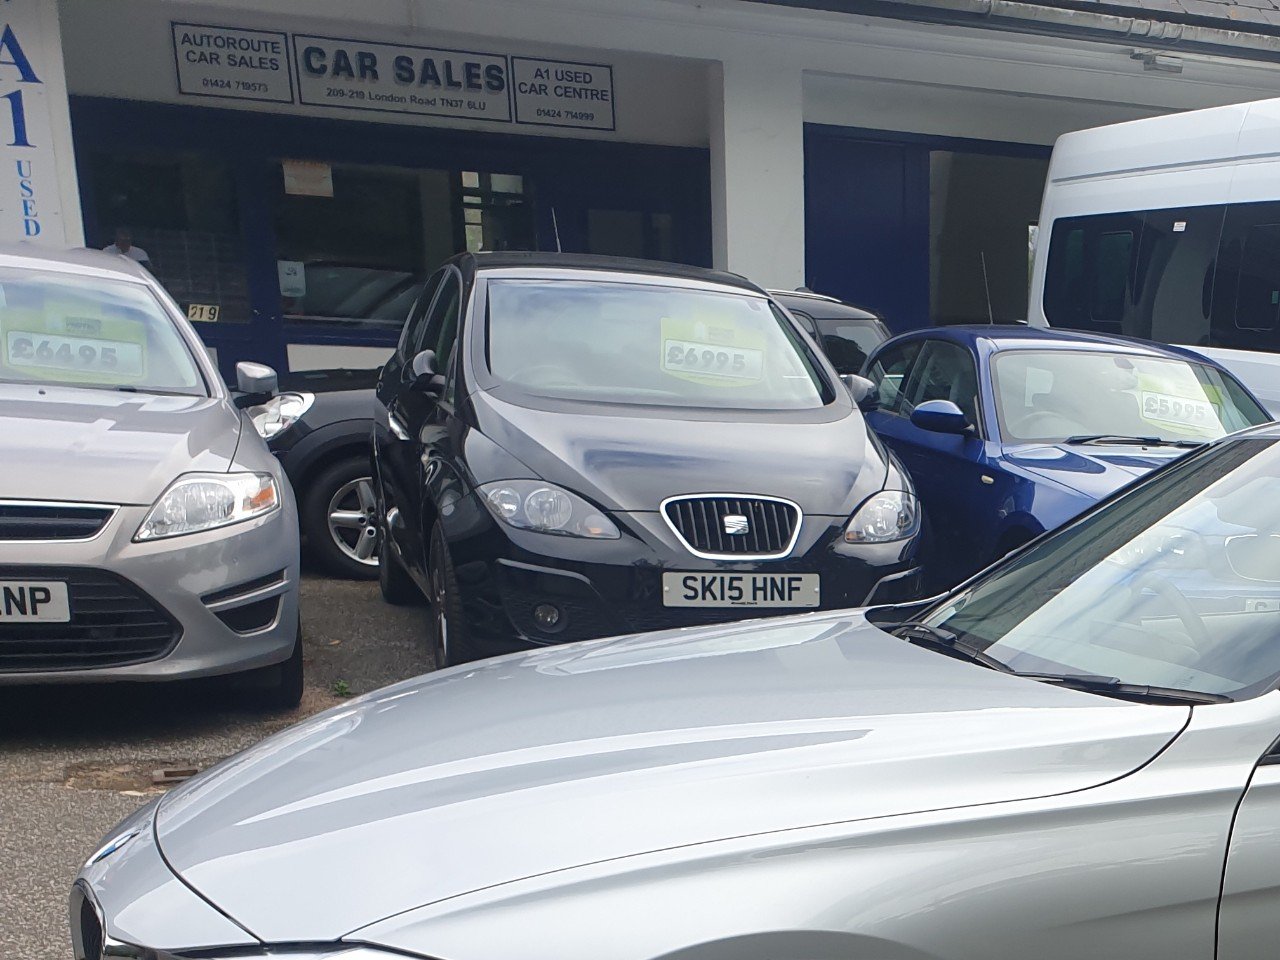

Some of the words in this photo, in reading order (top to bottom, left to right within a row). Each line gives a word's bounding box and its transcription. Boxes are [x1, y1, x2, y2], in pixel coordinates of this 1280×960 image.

[181, 33, 281, 54] AUTOROUTE
[186, 50, 220, 65] CAR
[227, 54, 280, 71] SALES
[303, 46, 379, 81] CAR
[394, 55, 506, 92] SALES
[202, 77, 232, 89] 01424
[534, 67, 551, 80] A1
[555, 70, 593, 84] USED
[368, 91, 407, 103] London
[410, 94, 437, 106] Road
[440, 97, 464, 109] TN37
[467, 101, 486, 111] 6LU
[518, 82, 548, 96] CAR
[554, 86, 610, 102] CENTRE
[536, 108, 562, 119] 01424
[564, 110, 595, 121] 714999
[16, 160, 41, 237] USED
[190, 305, 217, 320] 219
[11, 338, 118, 367] £6495
[667, 346, 745, 371] £6995
[1144, 397, 1206, 420] £5995
[682, 575, 743, 601] SK15
[752, 576, 803, 602] HNF
[0, 586, 51, 615] NP
